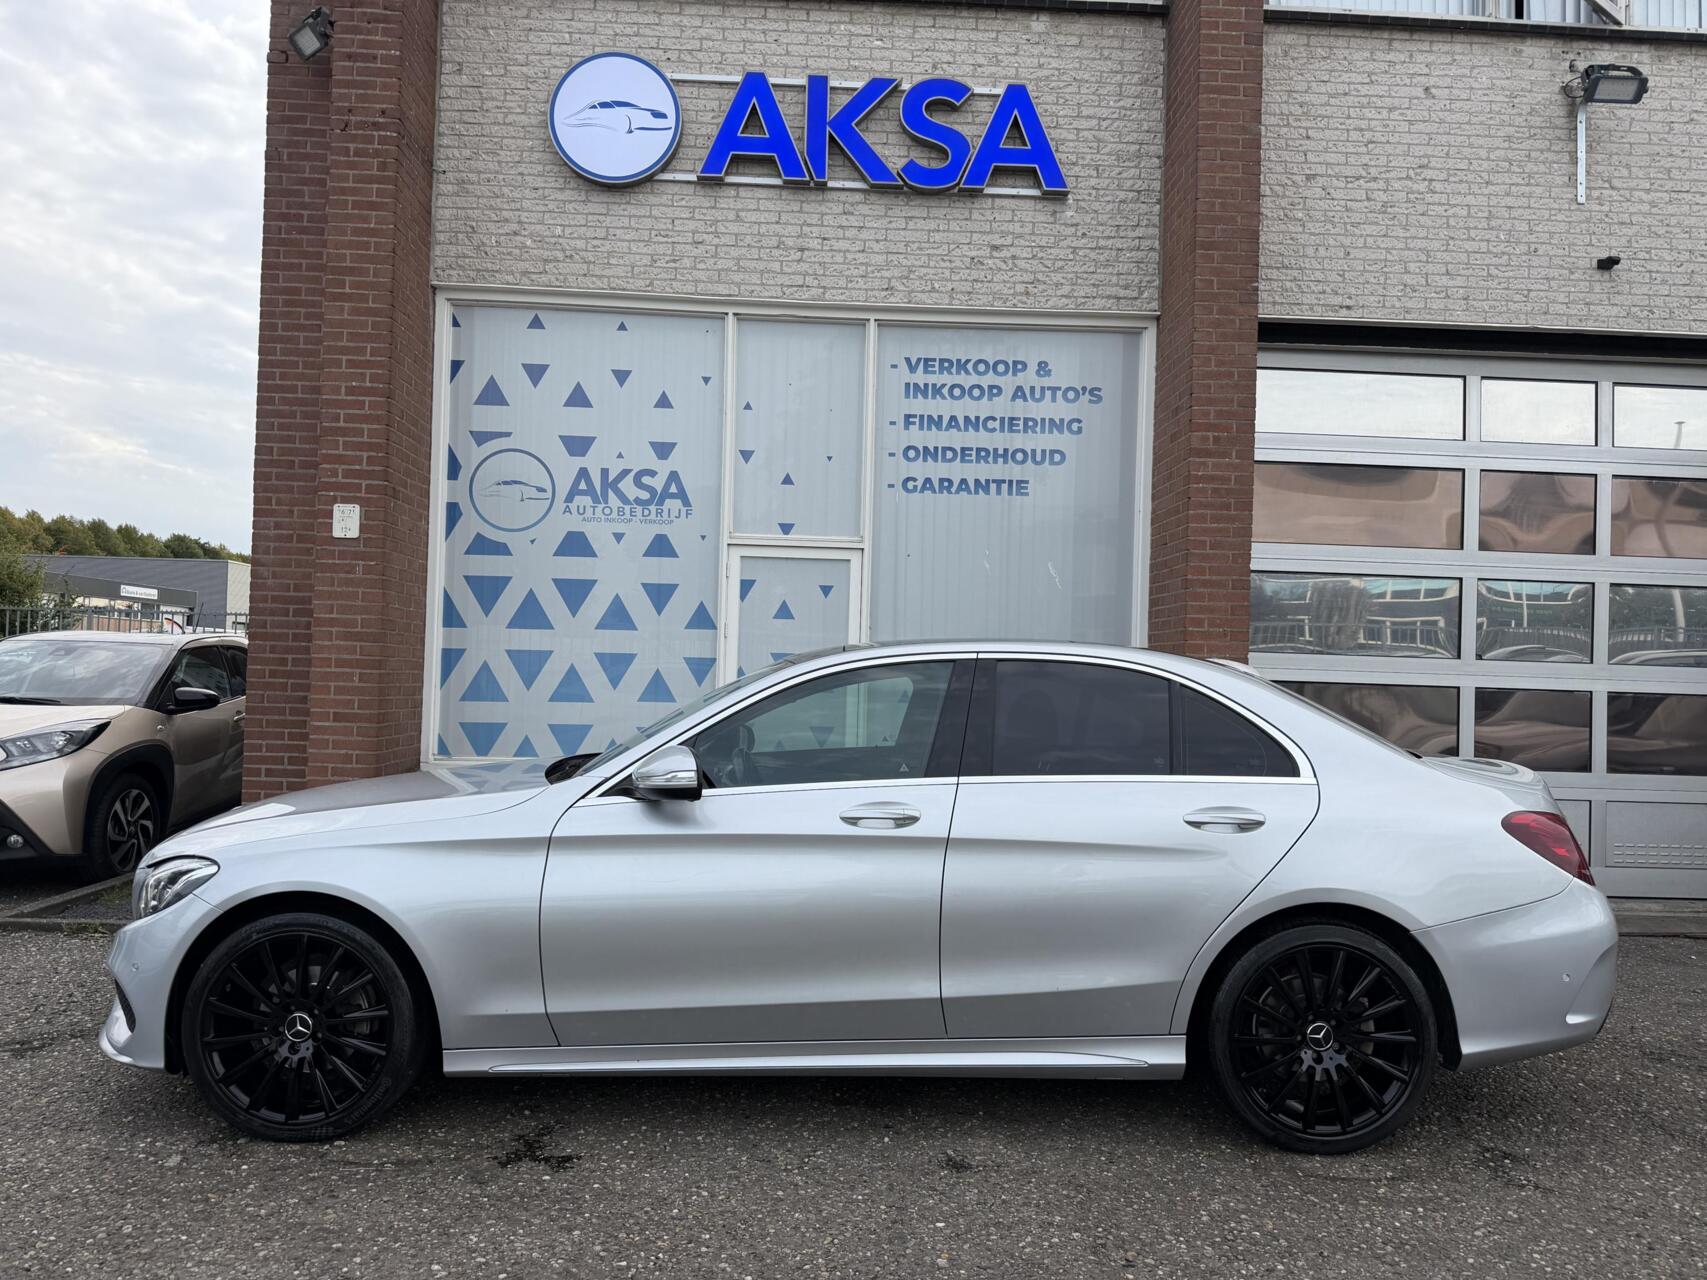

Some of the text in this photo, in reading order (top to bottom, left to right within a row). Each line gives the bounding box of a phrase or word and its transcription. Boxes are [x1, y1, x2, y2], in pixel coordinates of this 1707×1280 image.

[697, 72, 1070, 195] AKSA
[904, 357, 1027, 377] VERKOOP
[1036, 361, 1052, 378] &
[904, 382, 1003, 401] INKOOP
[903, 414, 1083, 435] FINANCIERING
[902, 445, 1066, 466] ONDERHOUD
[563, 467, 693, 507] AKSA
[901, 476, 1030, 497] GARANTIE
[562, 505, 693, 519] AUTOBEDRIJF
